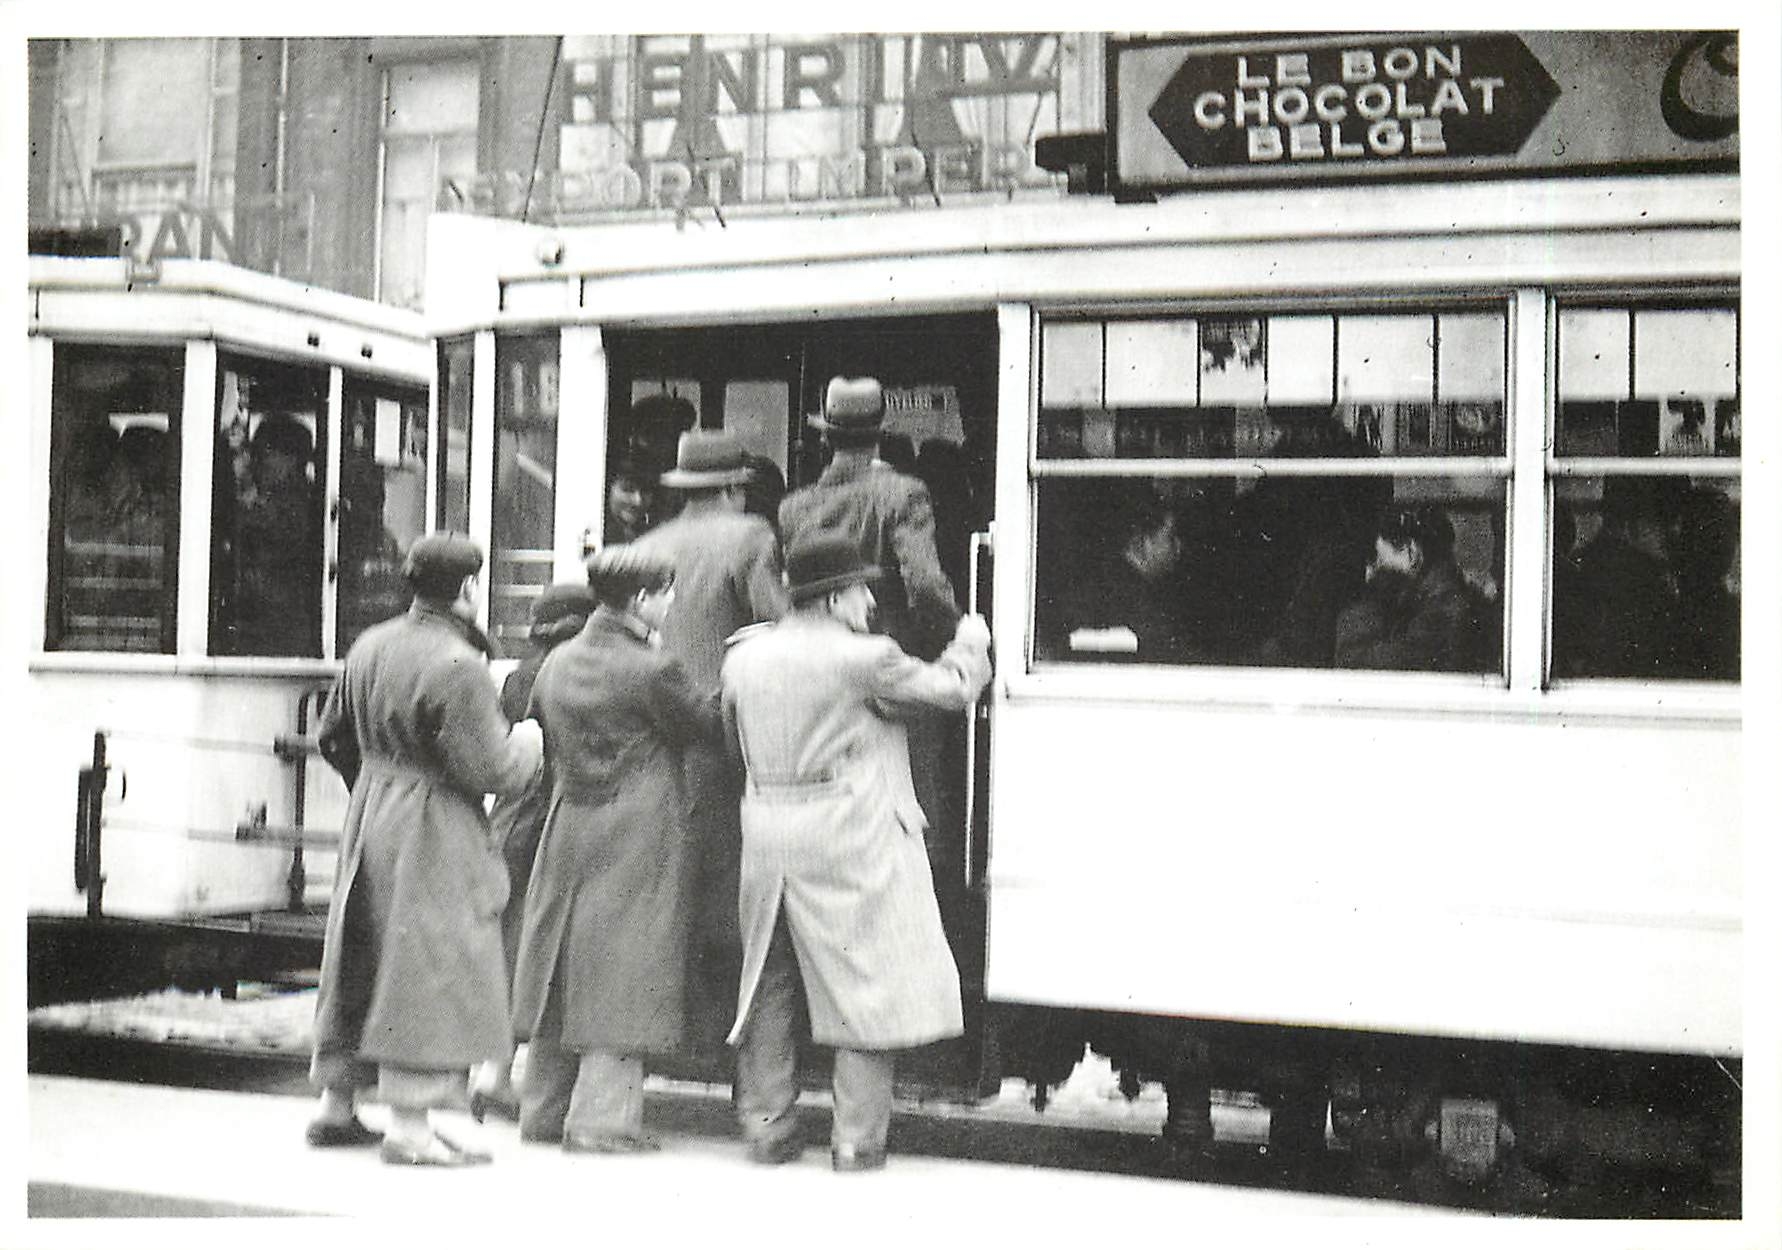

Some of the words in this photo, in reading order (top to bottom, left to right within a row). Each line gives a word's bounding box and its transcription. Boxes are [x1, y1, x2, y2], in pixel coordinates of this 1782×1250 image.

[554, 37, 886, 125] HENRI
[1237, 53, 1312, 89] LE
[1341, 45, 1462, 84] BON
[1193, 77, 1505, 129] CHOCOLAT
[1248, 119, 1447, 162] BELGE
